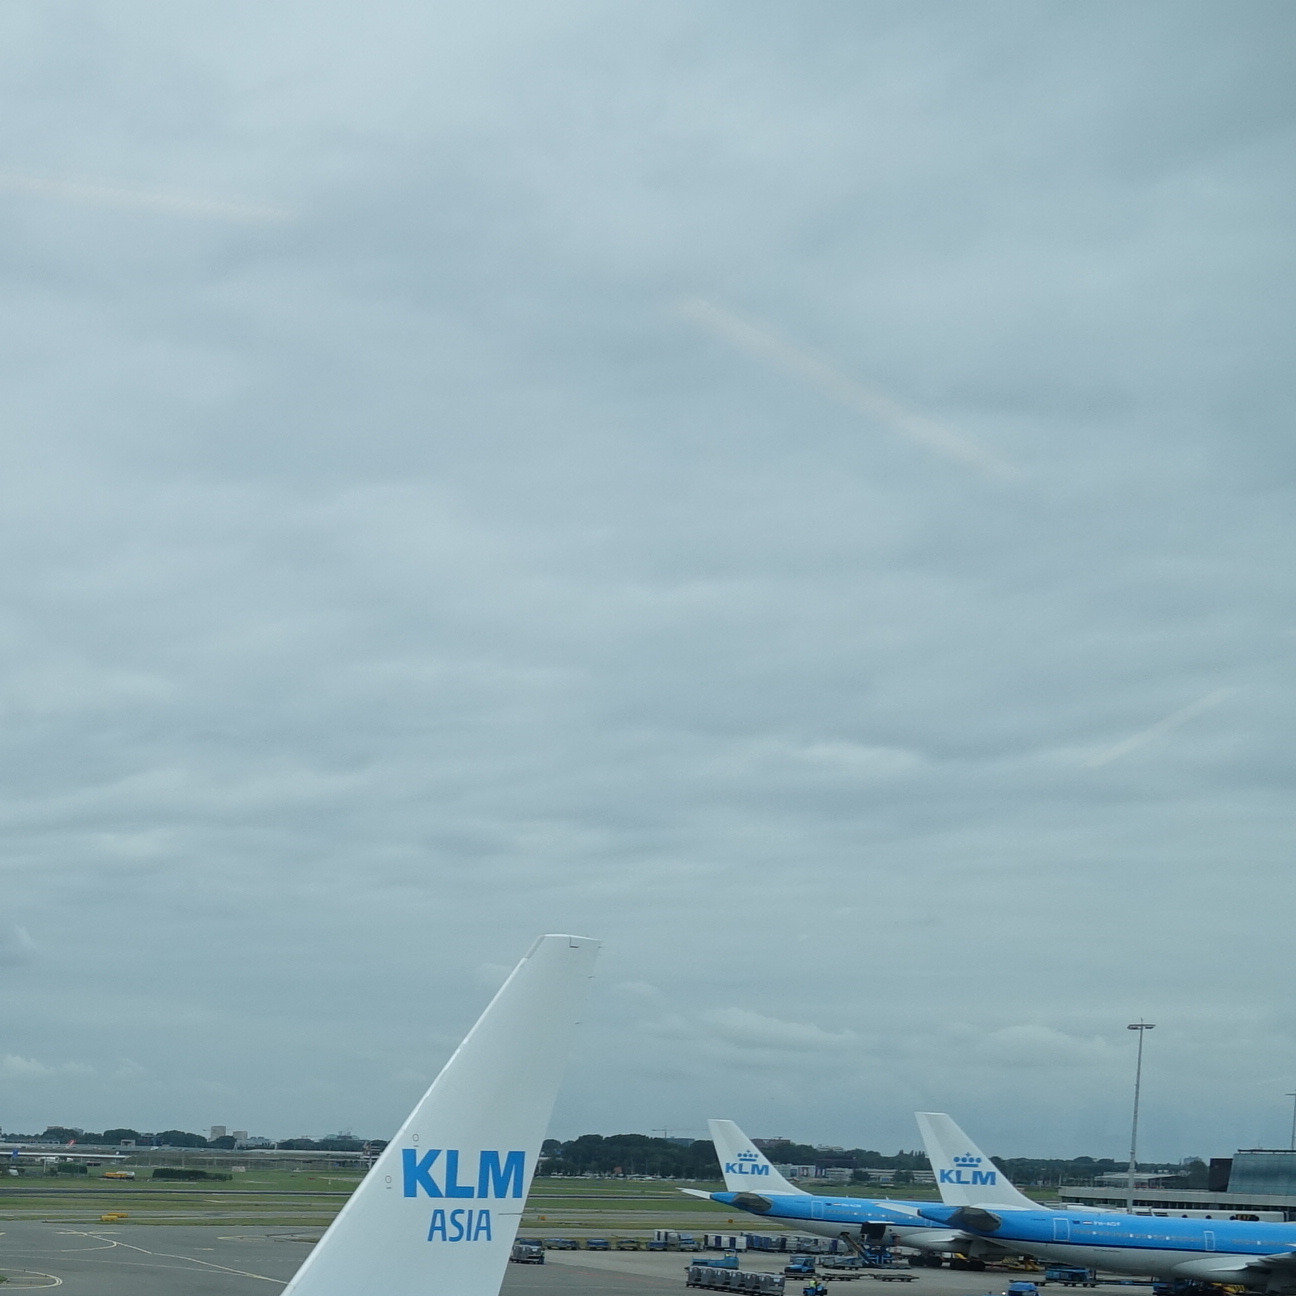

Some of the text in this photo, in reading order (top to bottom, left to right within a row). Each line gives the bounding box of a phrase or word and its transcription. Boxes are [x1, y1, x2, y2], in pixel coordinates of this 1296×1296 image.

[402, 1149, 526, 1198] KLM
[725, 1163, 769, 1175] KLM
[939, 1169, 996, 1186] KLM
[427, 1209, 492, 1242] ASIA
